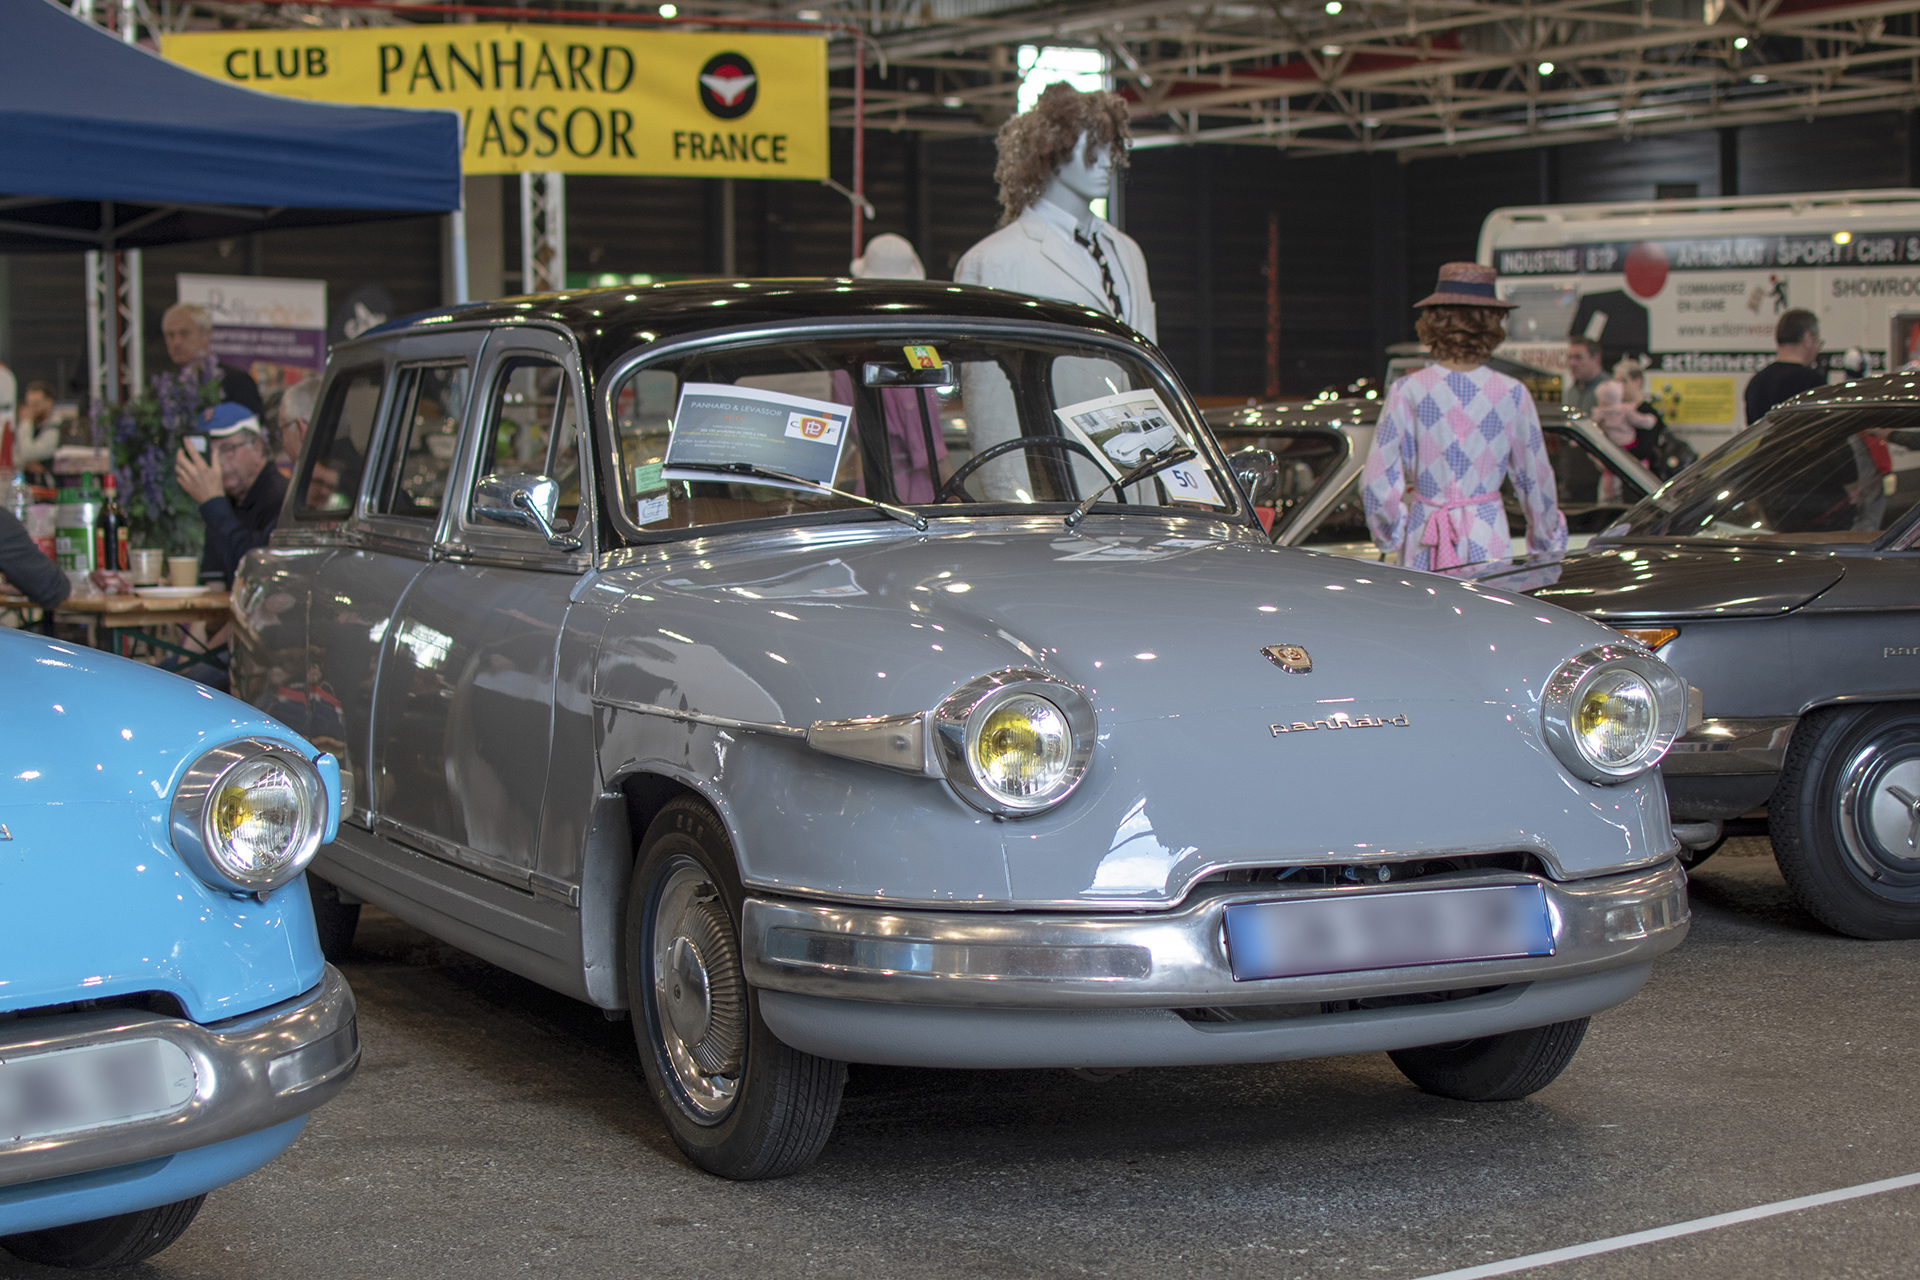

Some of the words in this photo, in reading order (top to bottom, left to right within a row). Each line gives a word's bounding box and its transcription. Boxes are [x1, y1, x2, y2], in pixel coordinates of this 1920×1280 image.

[225, 47, 328, 79] CLUB
[378, 40, 636, 95] PANHARD
[672, 130, 788, 163] FRANCE
[1501, 250, 1579, 273] INDUSTRIE
[1586, 247, 1618, 271] BTP
[1777, 240, 1842, 265] SPORT
[1856, 238, 1896, 262] CHR
[690, 401, 731, 411] PANHARD
[740, 404, 782, 417] LEVASSOR
[1172, 469, 1198, 489] 50
[1268, 712, 1410, 738] panhard
